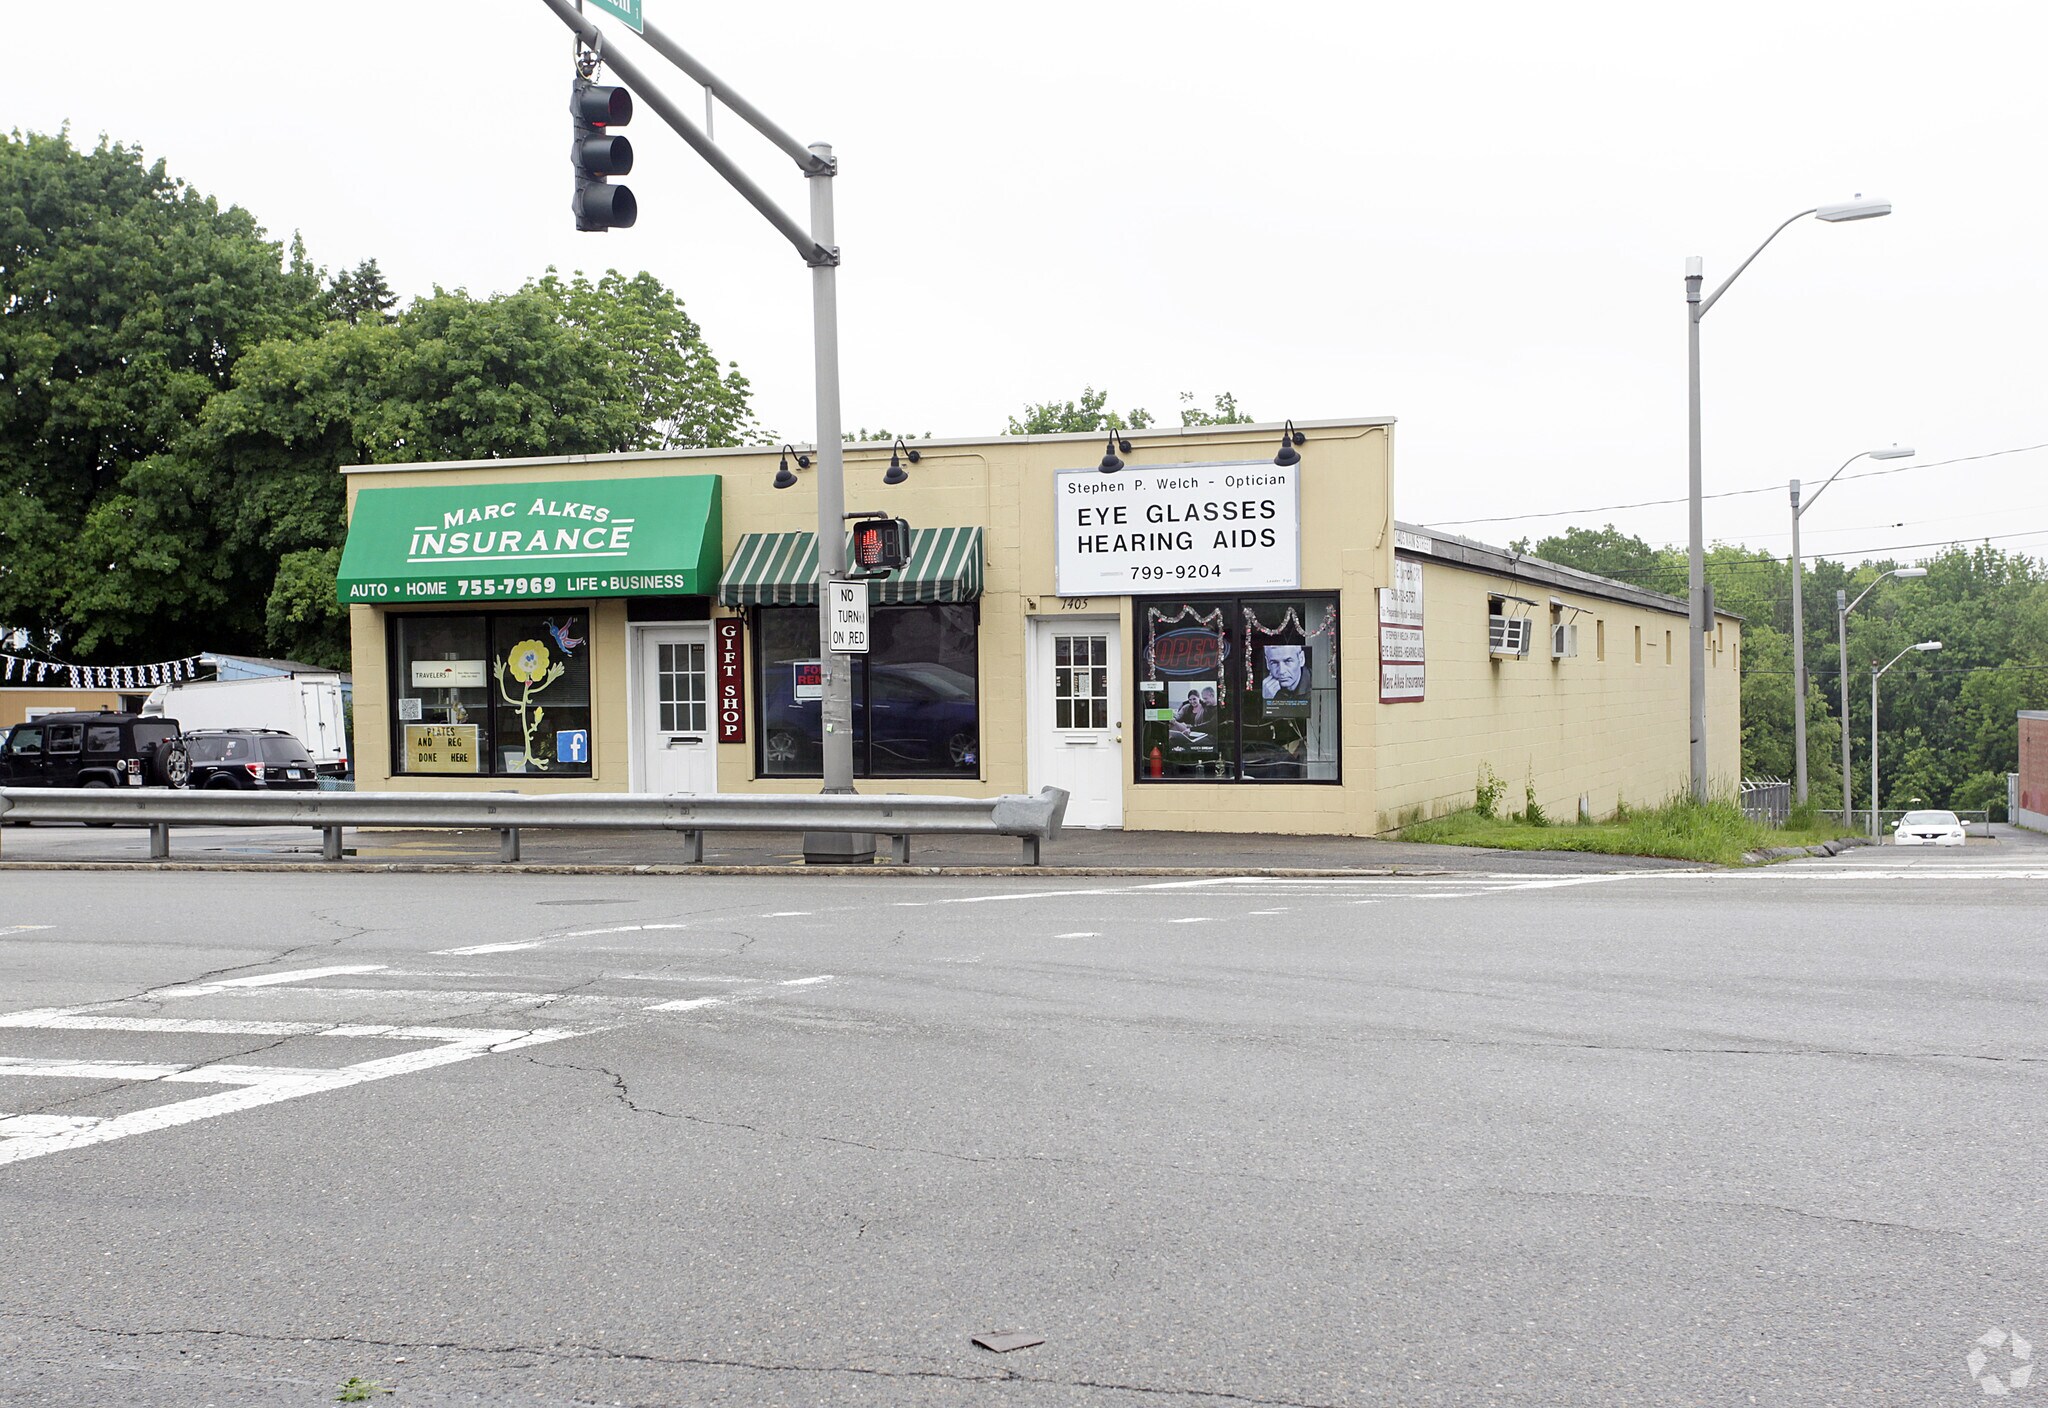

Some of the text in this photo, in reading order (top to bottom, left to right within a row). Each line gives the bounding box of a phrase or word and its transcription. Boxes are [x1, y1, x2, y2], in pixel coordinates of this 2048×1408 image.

[1068, 482, 1125, 495] Stephen
[1134, 480, 1147, 491] P.
[1156, 478, 1199, 490] Welch
[1225, 475, 1286, 488] Optician
[444, 498, 610, 530] MARC ALKES
[1078, 500, 1276, 527] EYE GLASSES
[407, 525, 634, 556] INSURANCE
[1078, 528, 1276, 553] HEARING AIDS
[1130, 564, 1222, 580] 799-9204
[350, 575, 684, 598] AUTO HOME 755-7969 LIFE BUSINESS
[841, 589, 854, 602] NO
[1061, 598, 1088, 610] 1405
[838, 610, 859, 623] TURN
[833, 631, 865, 645] ON RED
[721, 625, 737, 677] GIFT
[1155, 637, 1219, 667] OPEN
[415, 671, 447, 679] TRAVELERS
[804, 666, 821, 675] FO
[798, 675, 821, 685] REN
[722, 685, 739, 736] SHOP
[427, 727, 455, 737] PLATES
[417, 738, 462, 747] AND REG
[418, 752, 468, 763] DONE HERE
